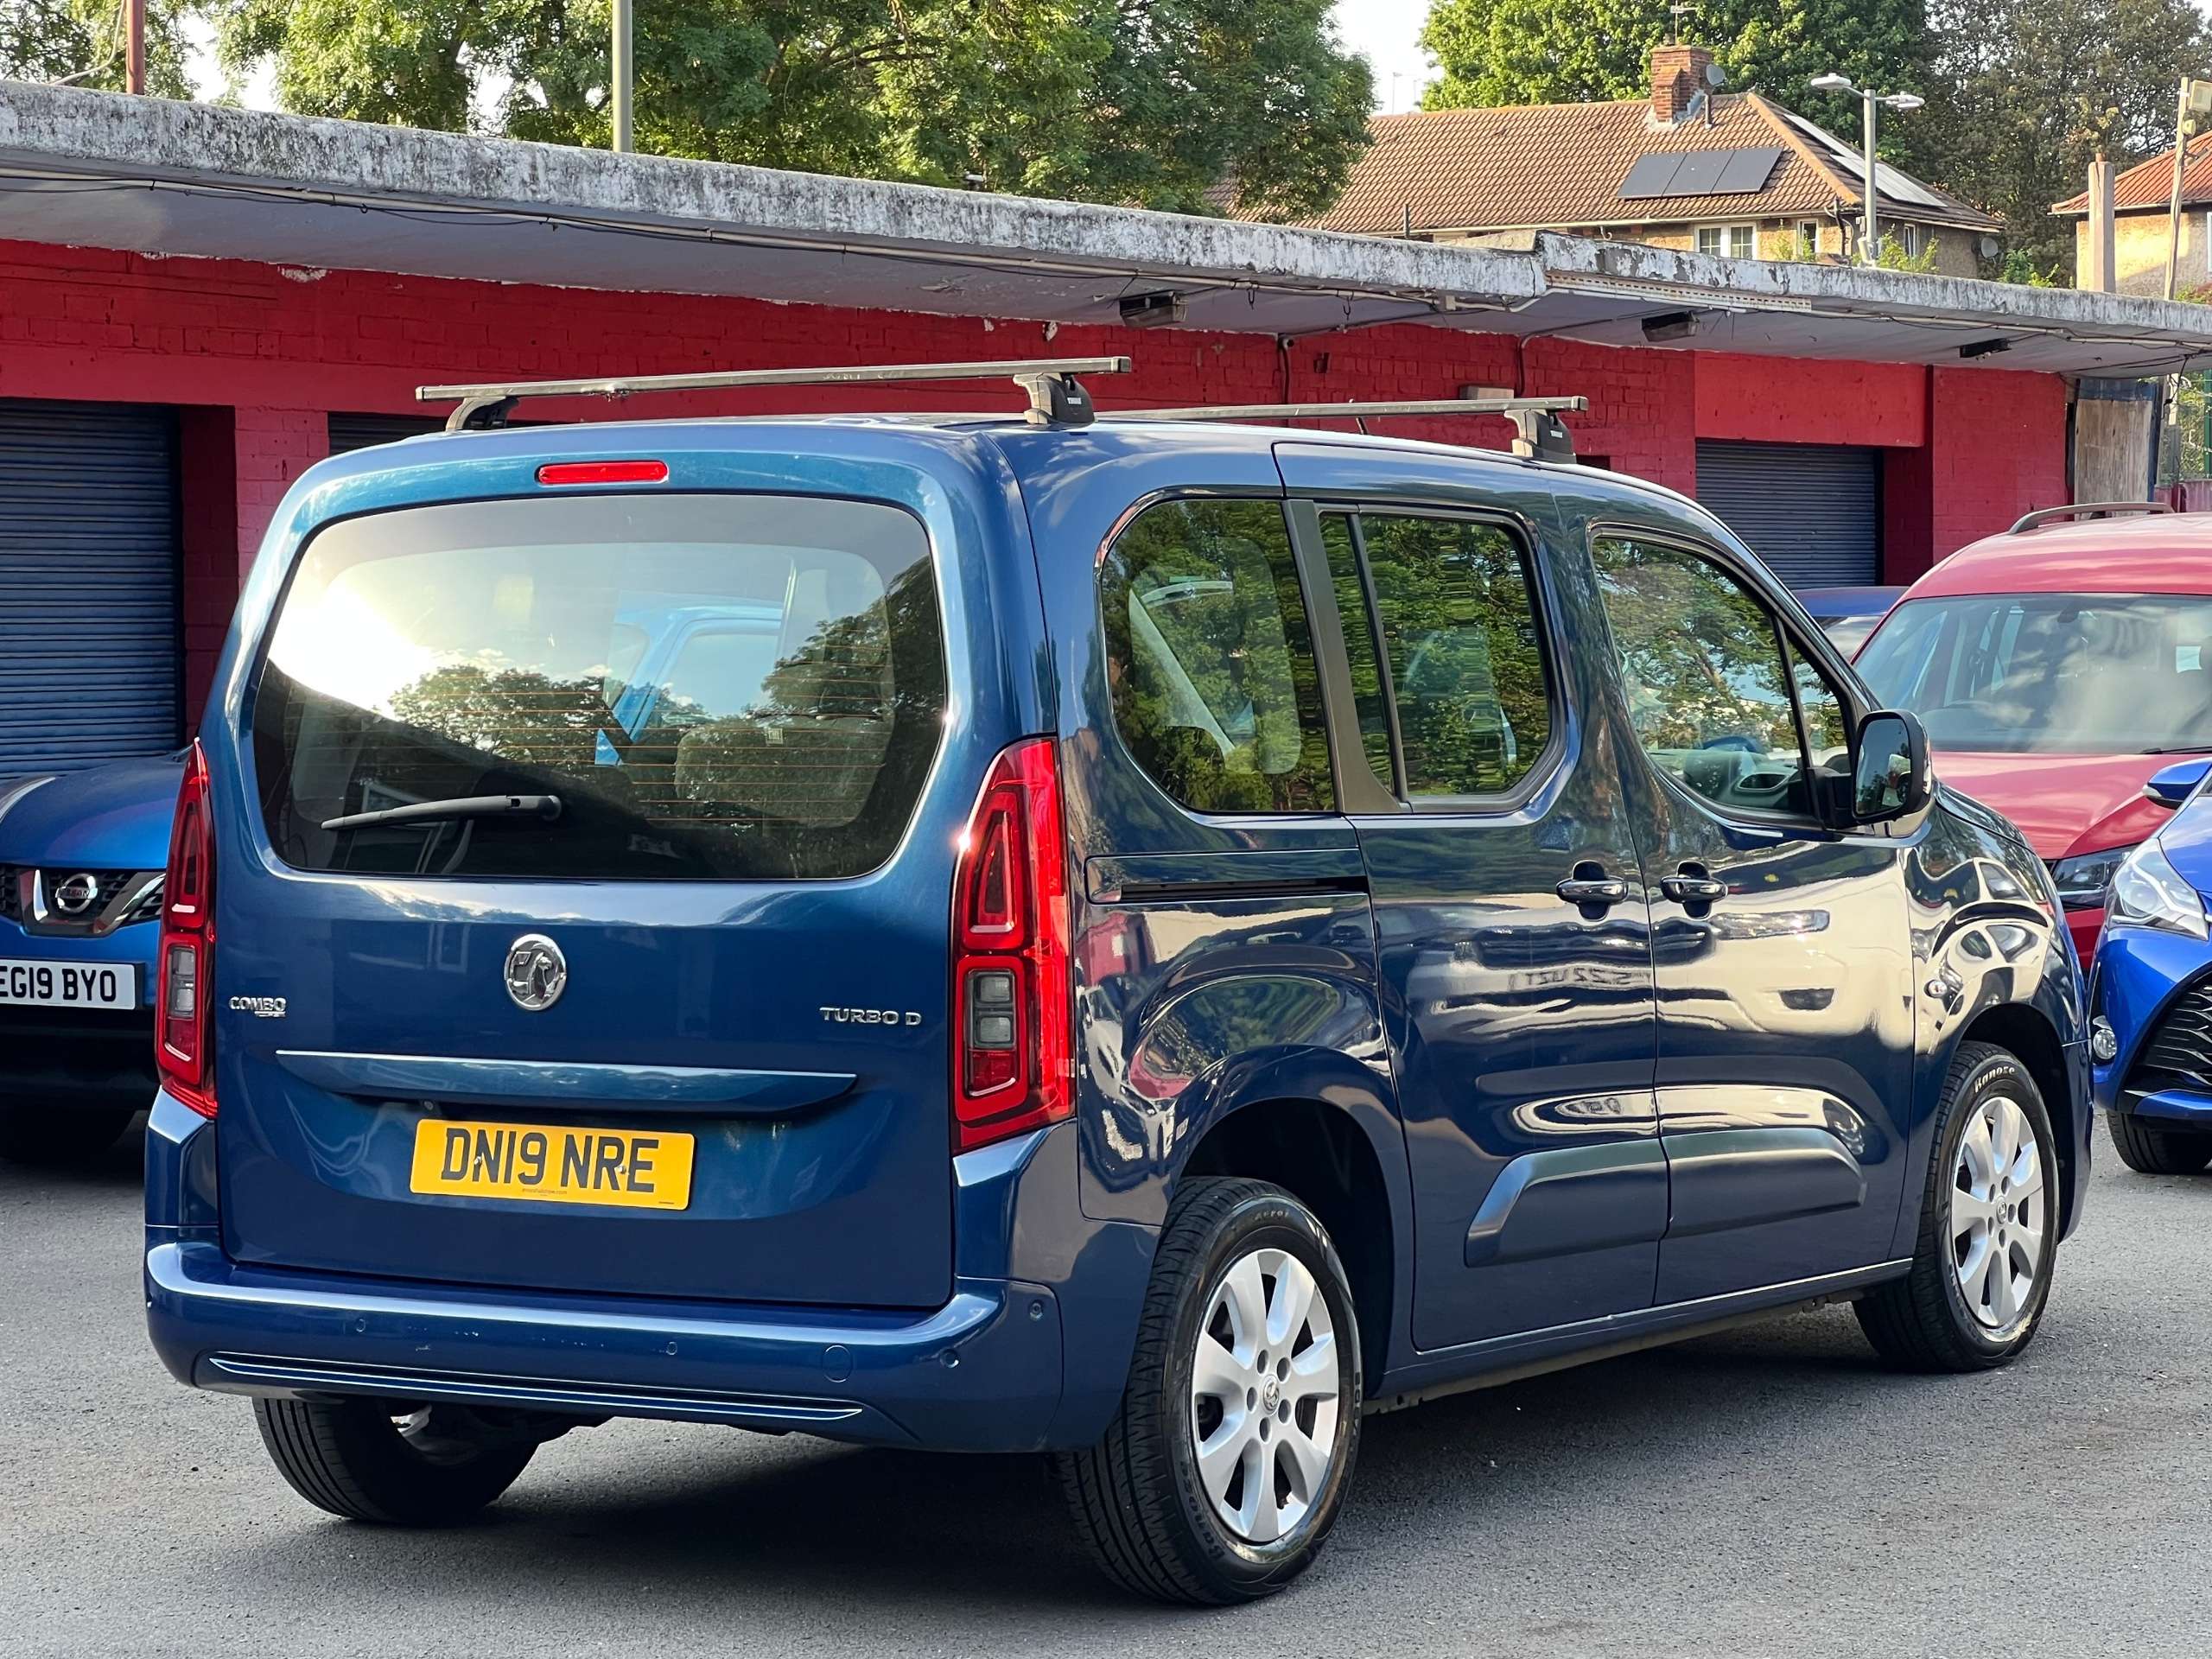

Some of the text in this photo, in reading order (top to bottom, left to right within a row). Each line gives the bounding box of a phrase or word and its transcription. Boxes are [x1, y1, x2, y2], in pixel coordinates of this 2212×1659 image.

[62, 968, 117, 1002] BYO
[228, 996, 287, 1012] COMBO
[819, 1007, 922, 1026] TURBO D
[441, 1127, 659, 1193] DN19 NRE
